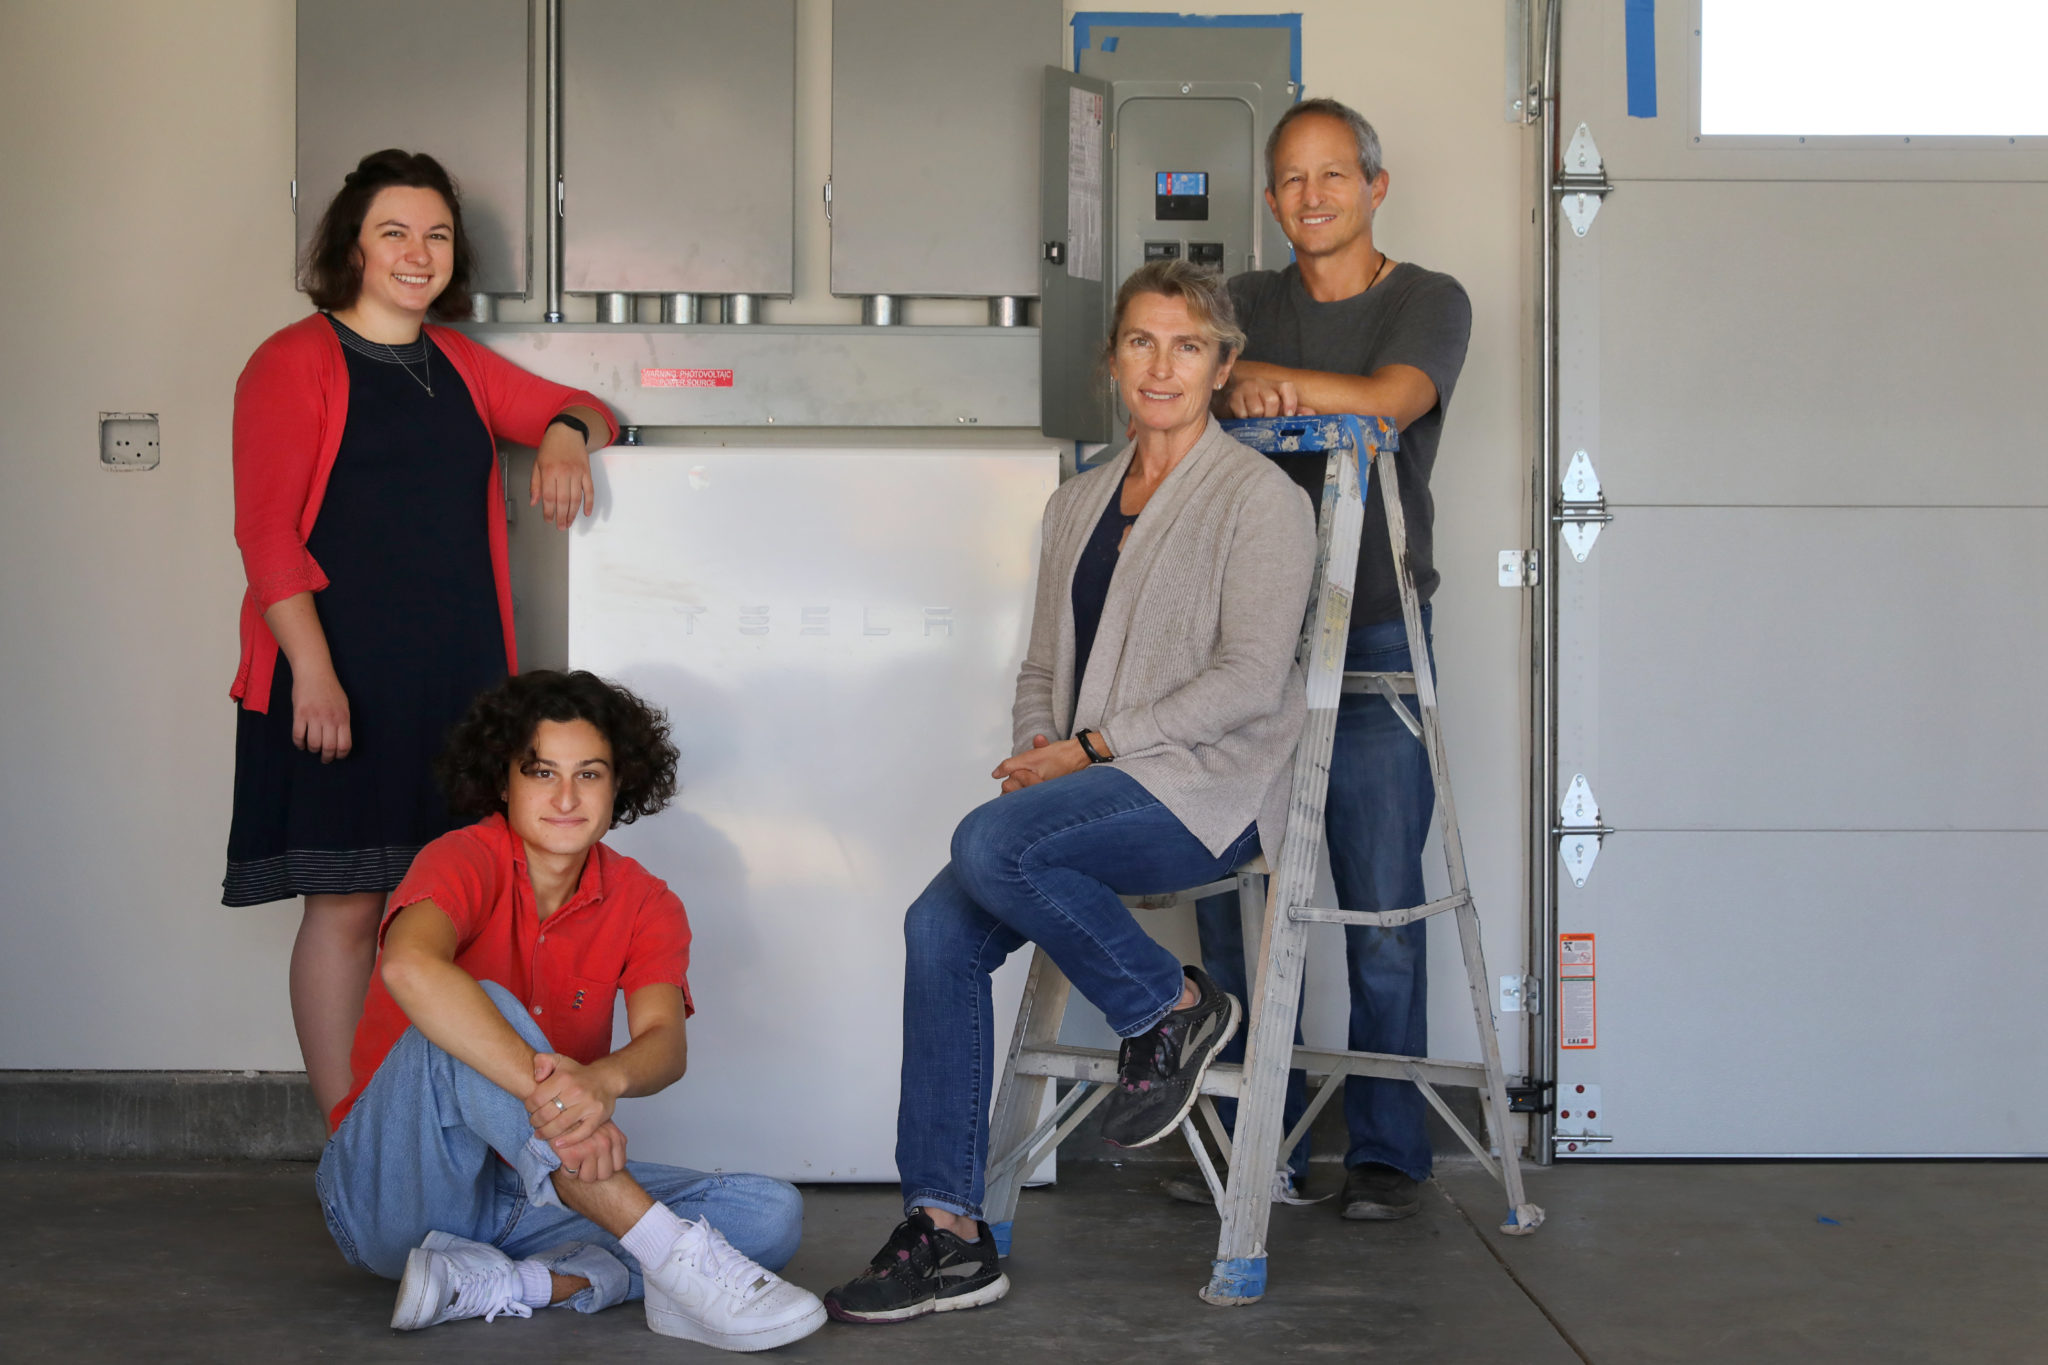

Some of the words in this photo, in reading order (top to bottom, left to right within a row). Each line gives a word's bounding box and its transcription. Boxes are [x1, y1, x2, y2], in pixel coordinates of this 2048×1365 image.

[680, 370, 732, 378] PHOTOVOLTAIC
[687, 379, 716, 387] SOURCE
[672, 605, 953, 637] TESLA
